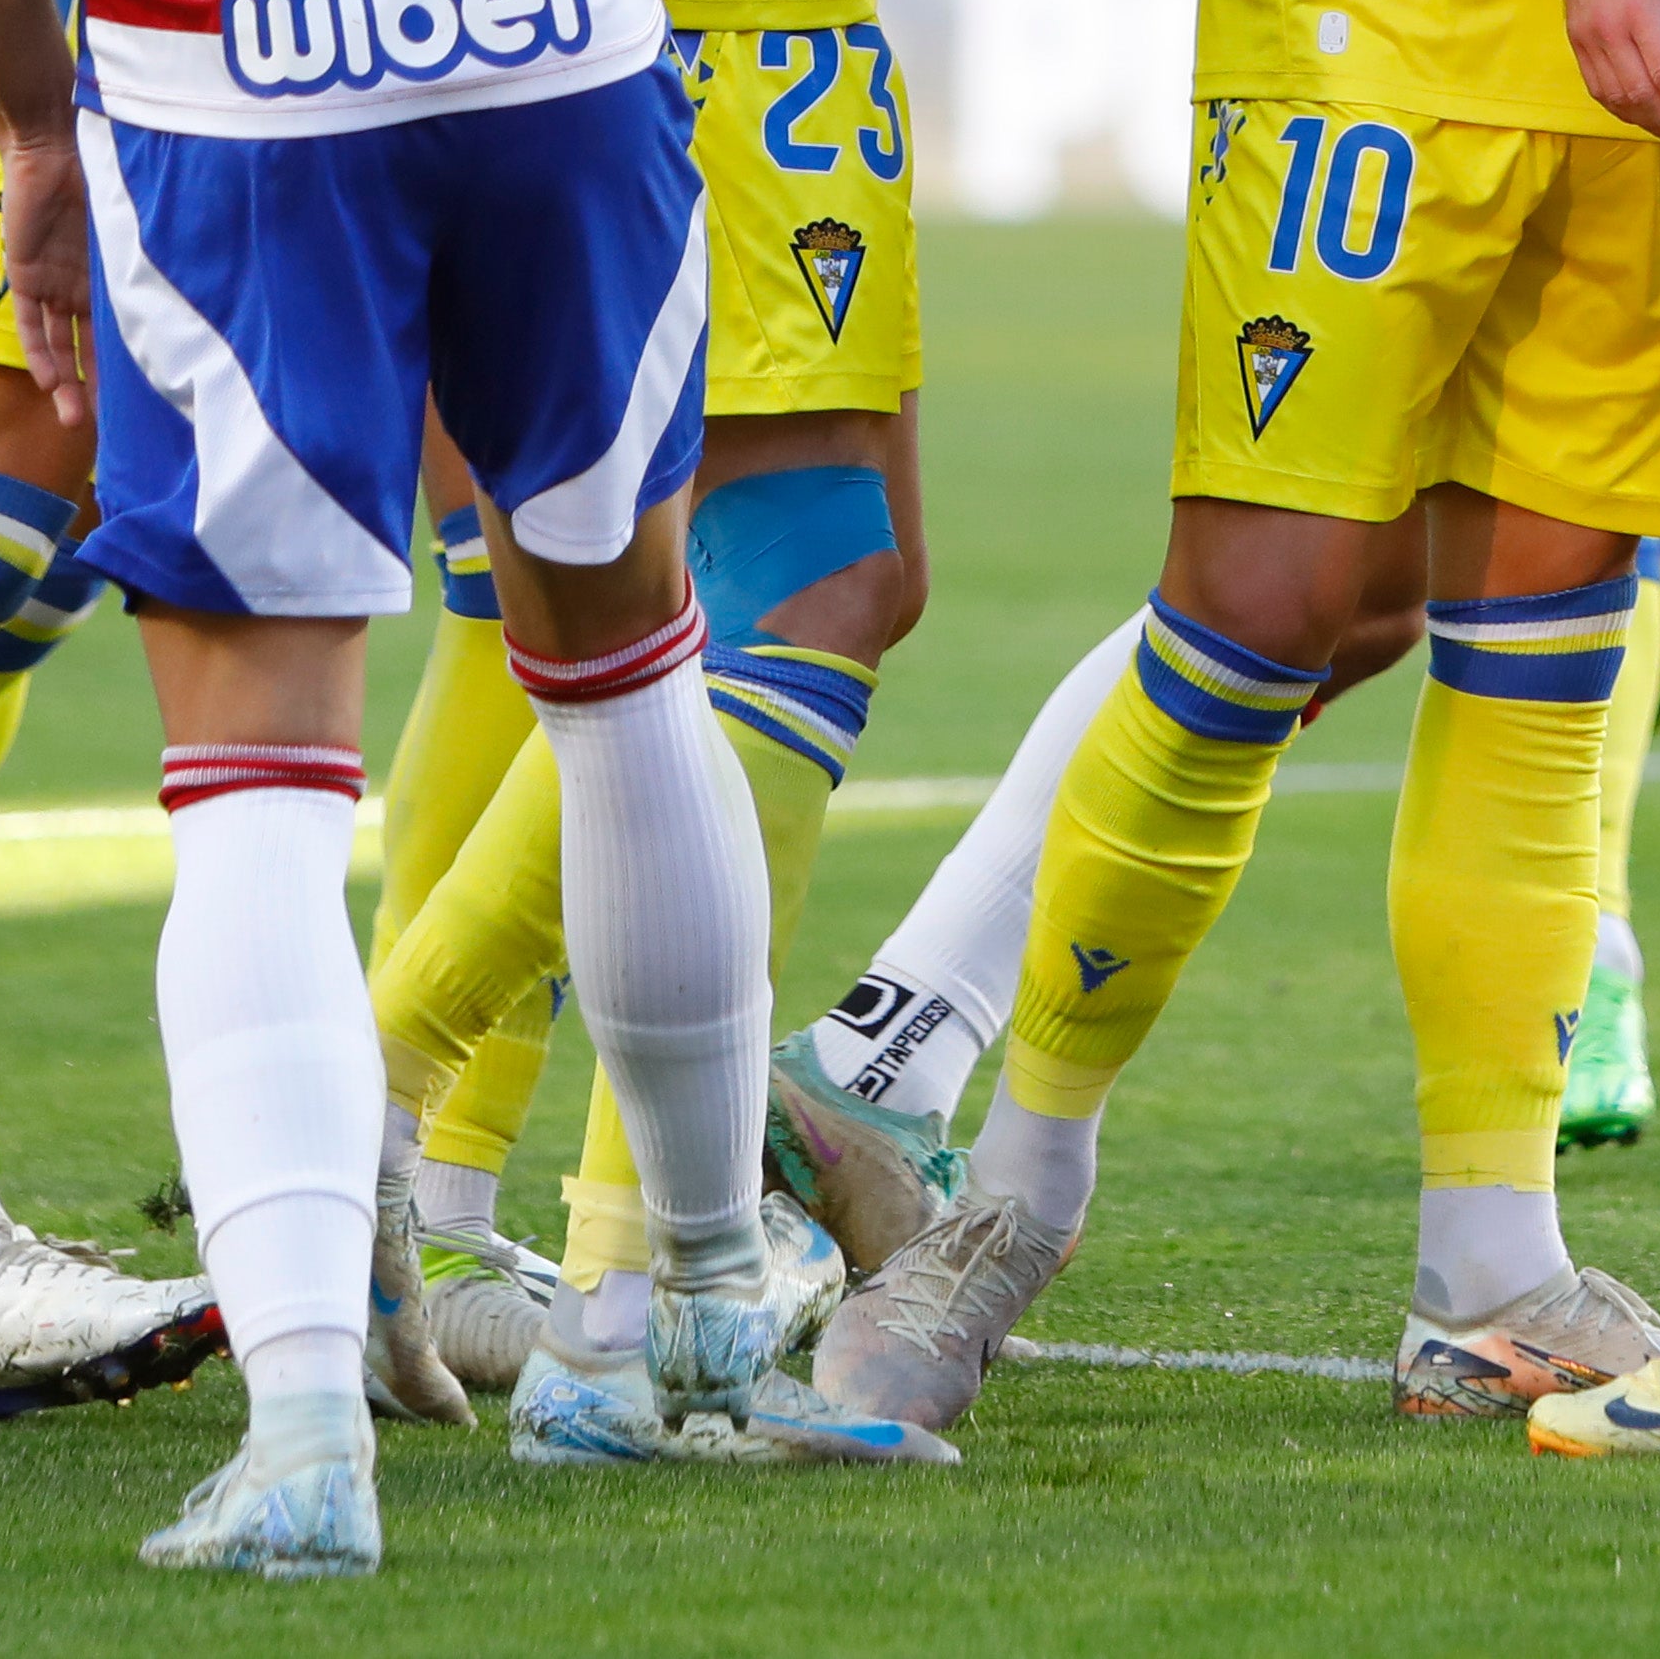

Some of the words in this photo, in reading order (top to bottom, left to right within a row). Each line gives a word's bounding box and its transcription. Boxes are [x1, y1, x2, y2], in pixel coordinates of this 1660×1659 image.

[757, 29, 905, 182] 23
[1267, 116, 1415, 281] 10
[874, 997, 953, 1073] TAPEDES
